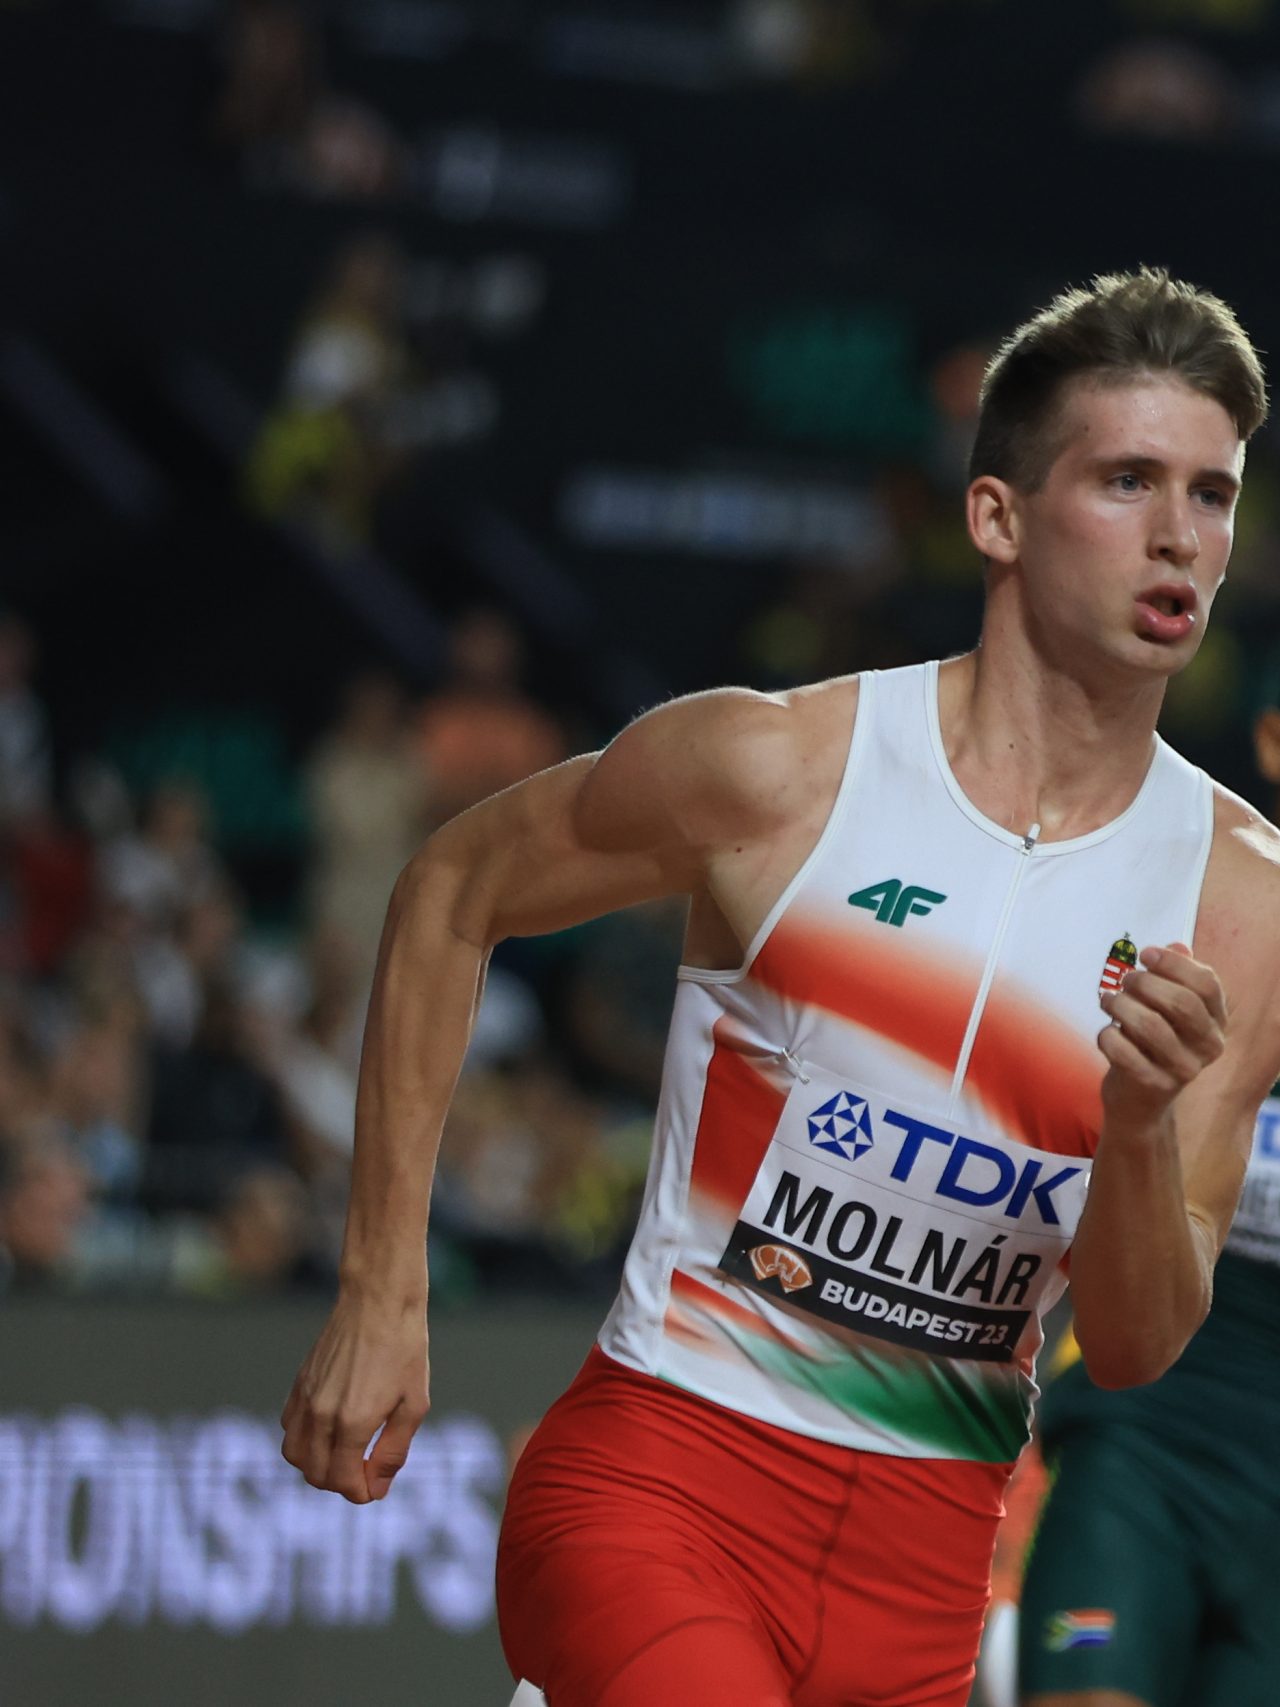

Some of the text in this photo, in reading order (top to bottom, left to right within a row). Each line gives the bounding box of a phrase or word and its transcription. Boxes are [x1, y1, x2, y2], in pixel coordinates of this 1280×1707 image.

[847, 878, 947, 928] 4F
[884, 1109, 1082, 1226] TDK
[761, 1169, 1042, 1307] MOLNÁR
